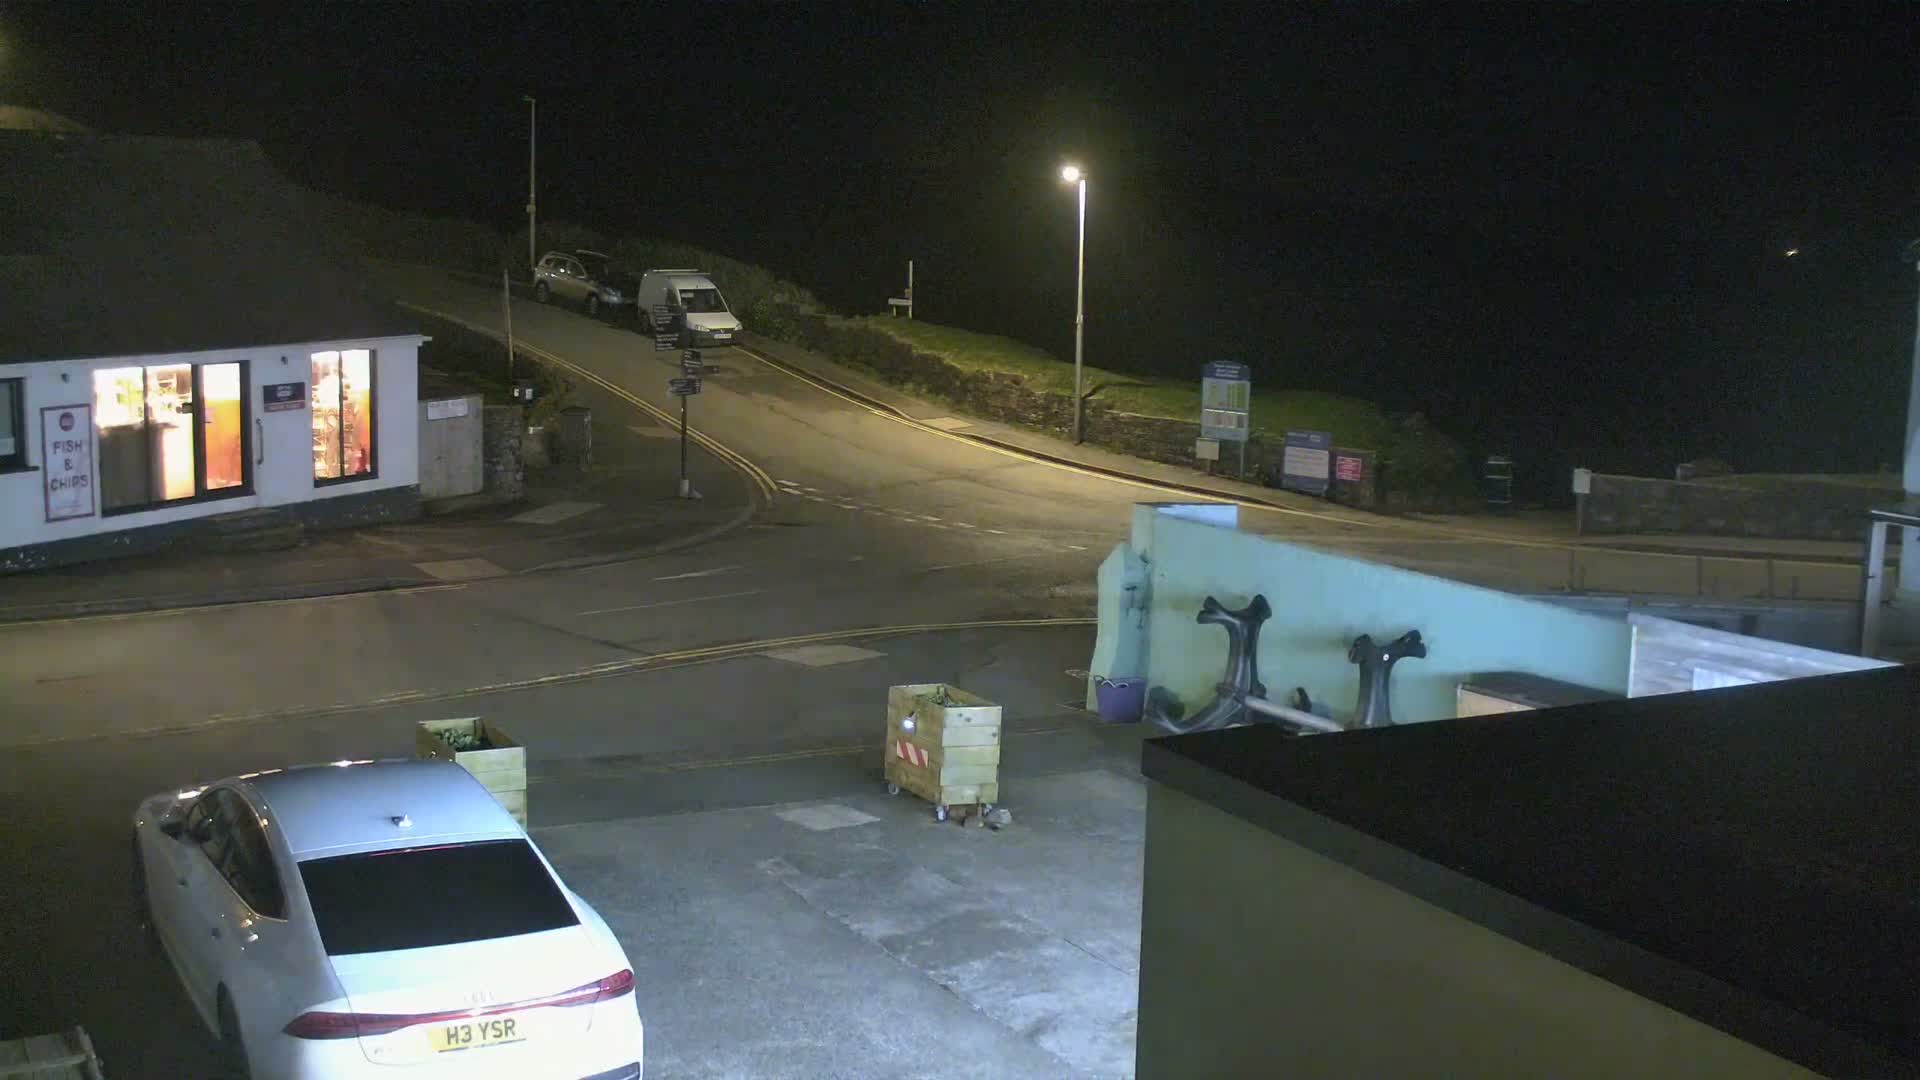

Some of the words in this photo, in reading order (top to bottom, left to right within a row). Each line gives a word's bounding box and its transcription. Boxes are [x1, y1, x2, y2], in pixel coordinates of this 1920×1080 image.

[53, 440, 82, 455] FISH
[63, 458, 73, 471] &
[50, 475, 88, 491] CHIPS
[446, 1024, 472, 1045] H3
[478, 1018, 516, 1040] YSR
